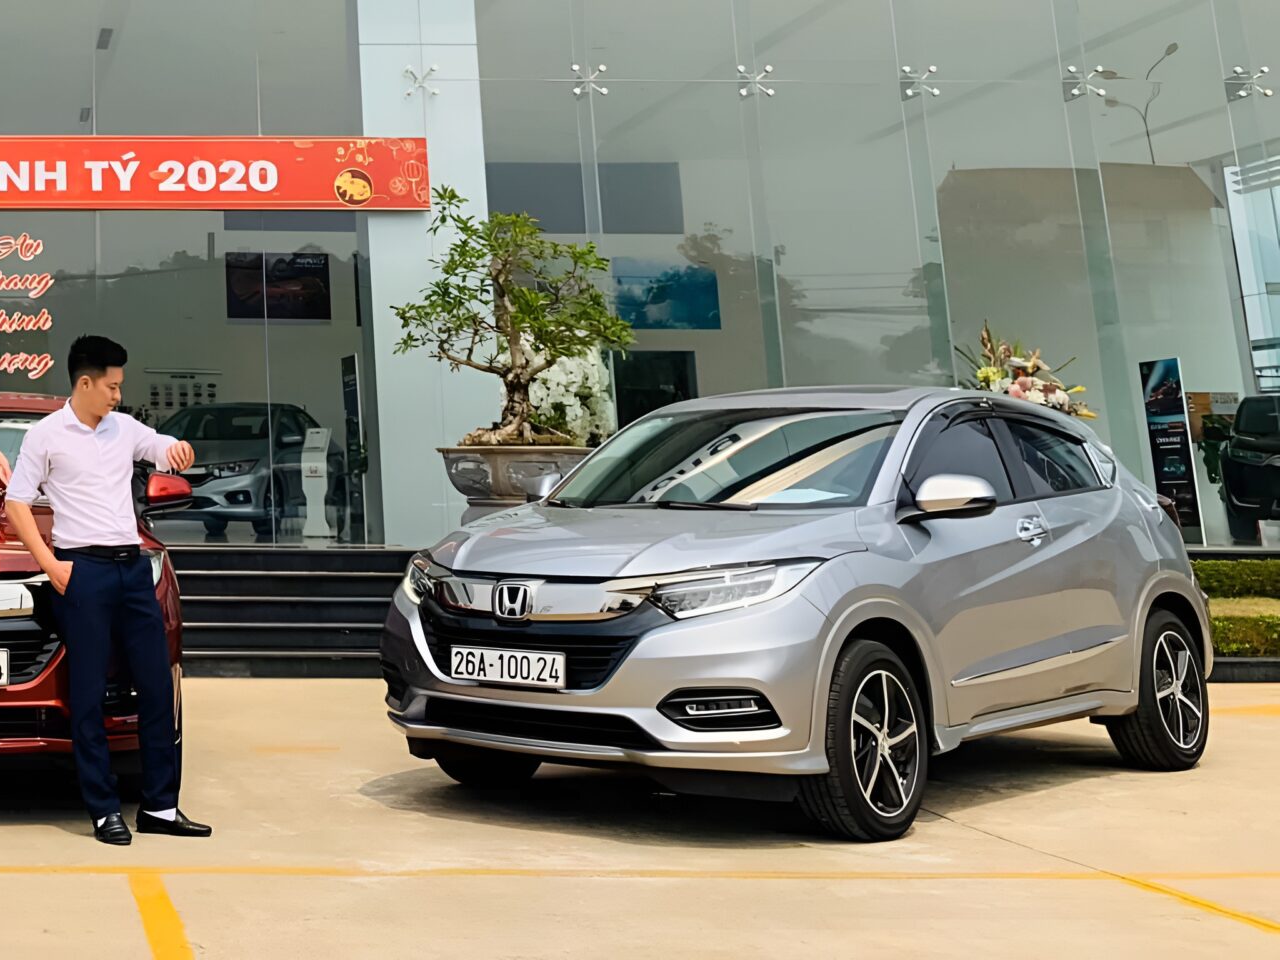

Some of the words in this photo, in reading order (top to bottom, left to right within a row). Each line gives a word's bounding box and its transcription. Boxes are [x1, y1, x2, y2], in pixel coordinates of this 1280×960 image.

[84, 151, 141, 192] TÝ
[157, 159, 279, 192] 2020
[454, 651, 560, 683] 26A-100.24
